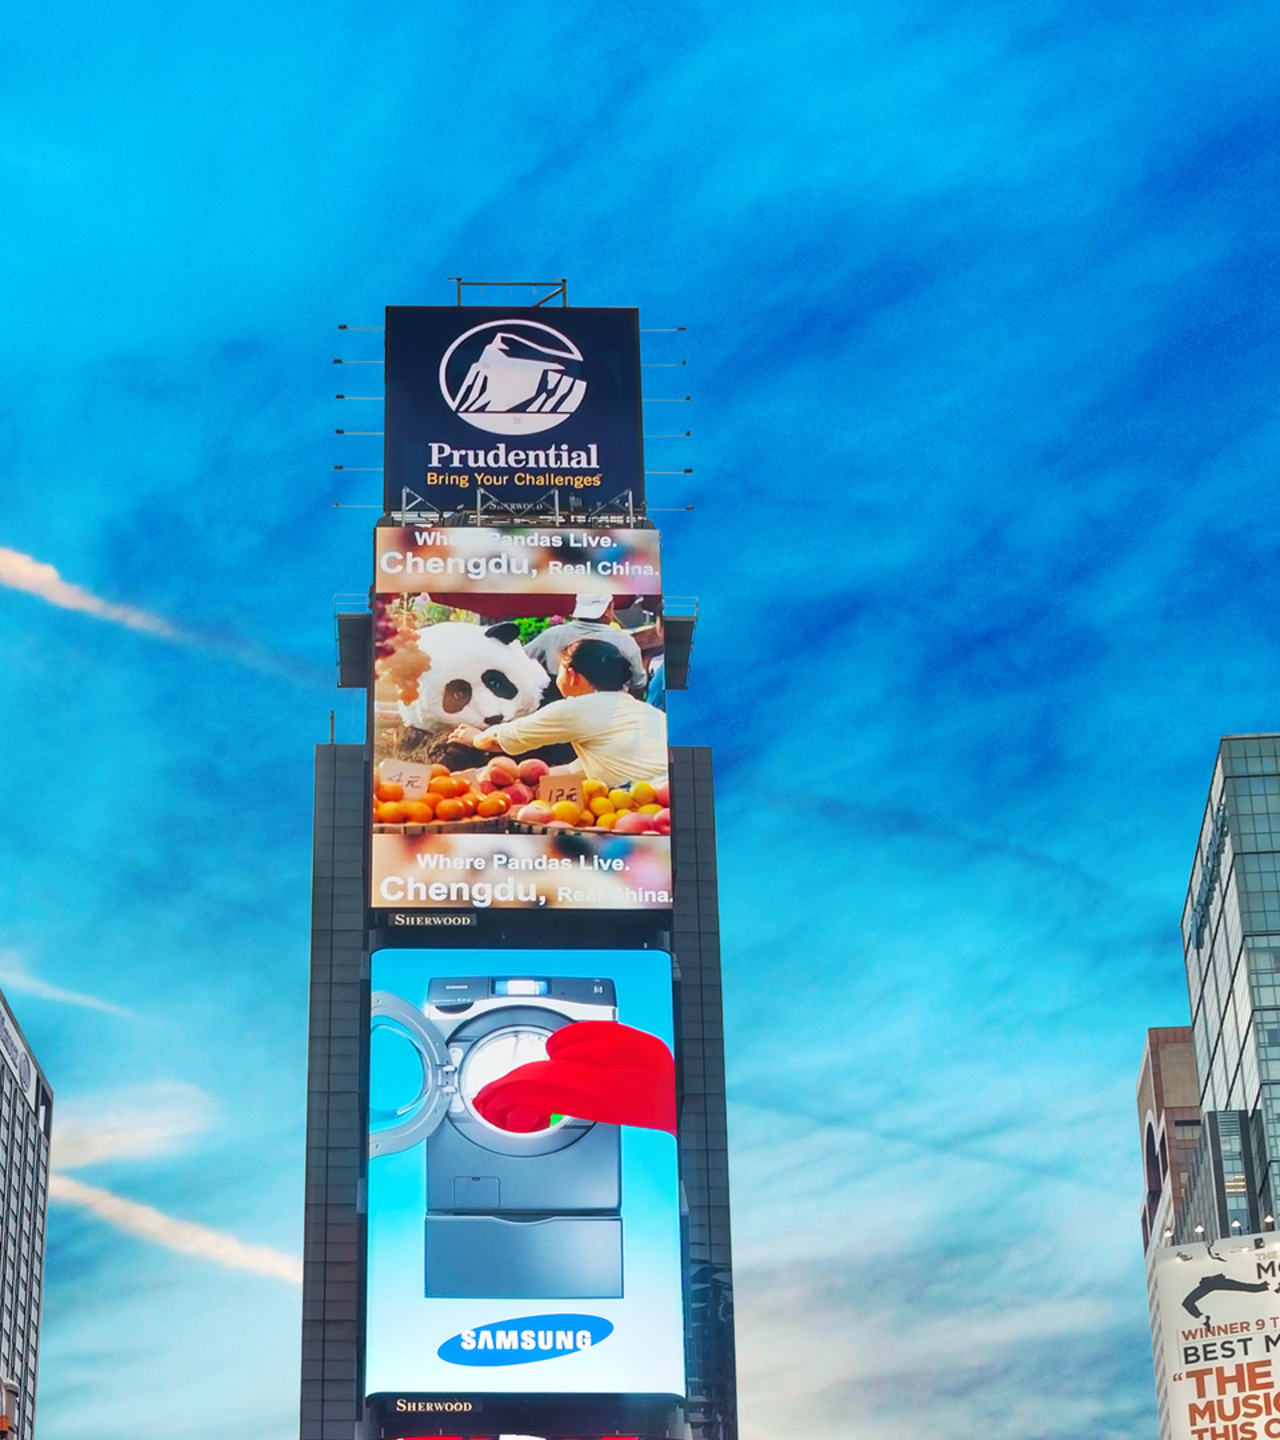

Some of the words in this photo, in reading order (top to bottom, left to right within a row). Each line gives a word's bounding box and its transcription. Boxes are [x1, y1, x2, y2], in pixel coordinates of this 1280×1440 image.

[427, 442, 600, 469] Prudential
[427, 472, 470, 488] Bring
[474, 472, 509, 486] Your
[514, 472, 601, 488] Challenges
[569, 532, 617, 548] Live.
[380, 552, 538, 579] Chengdu,
[549, 561, 592, 576] Real
[597, 561, 659, 576] China.
[416, 853, 486, 871] Where
[493, 854, 571, 871] Pandas
[580, 854, 630, 871] Live.
[395, 914, 471, 927] SHERWOOD
[1182, 1321, 1250, 1341] WINNER
[1255, 1318, 1266, 1330] 9
[460, 1329, 593, 1352] SAMSUNG
[1183, 1337, 1253, 1365] BEST
[396, 1398, 473, 1412] SHERWOOD
